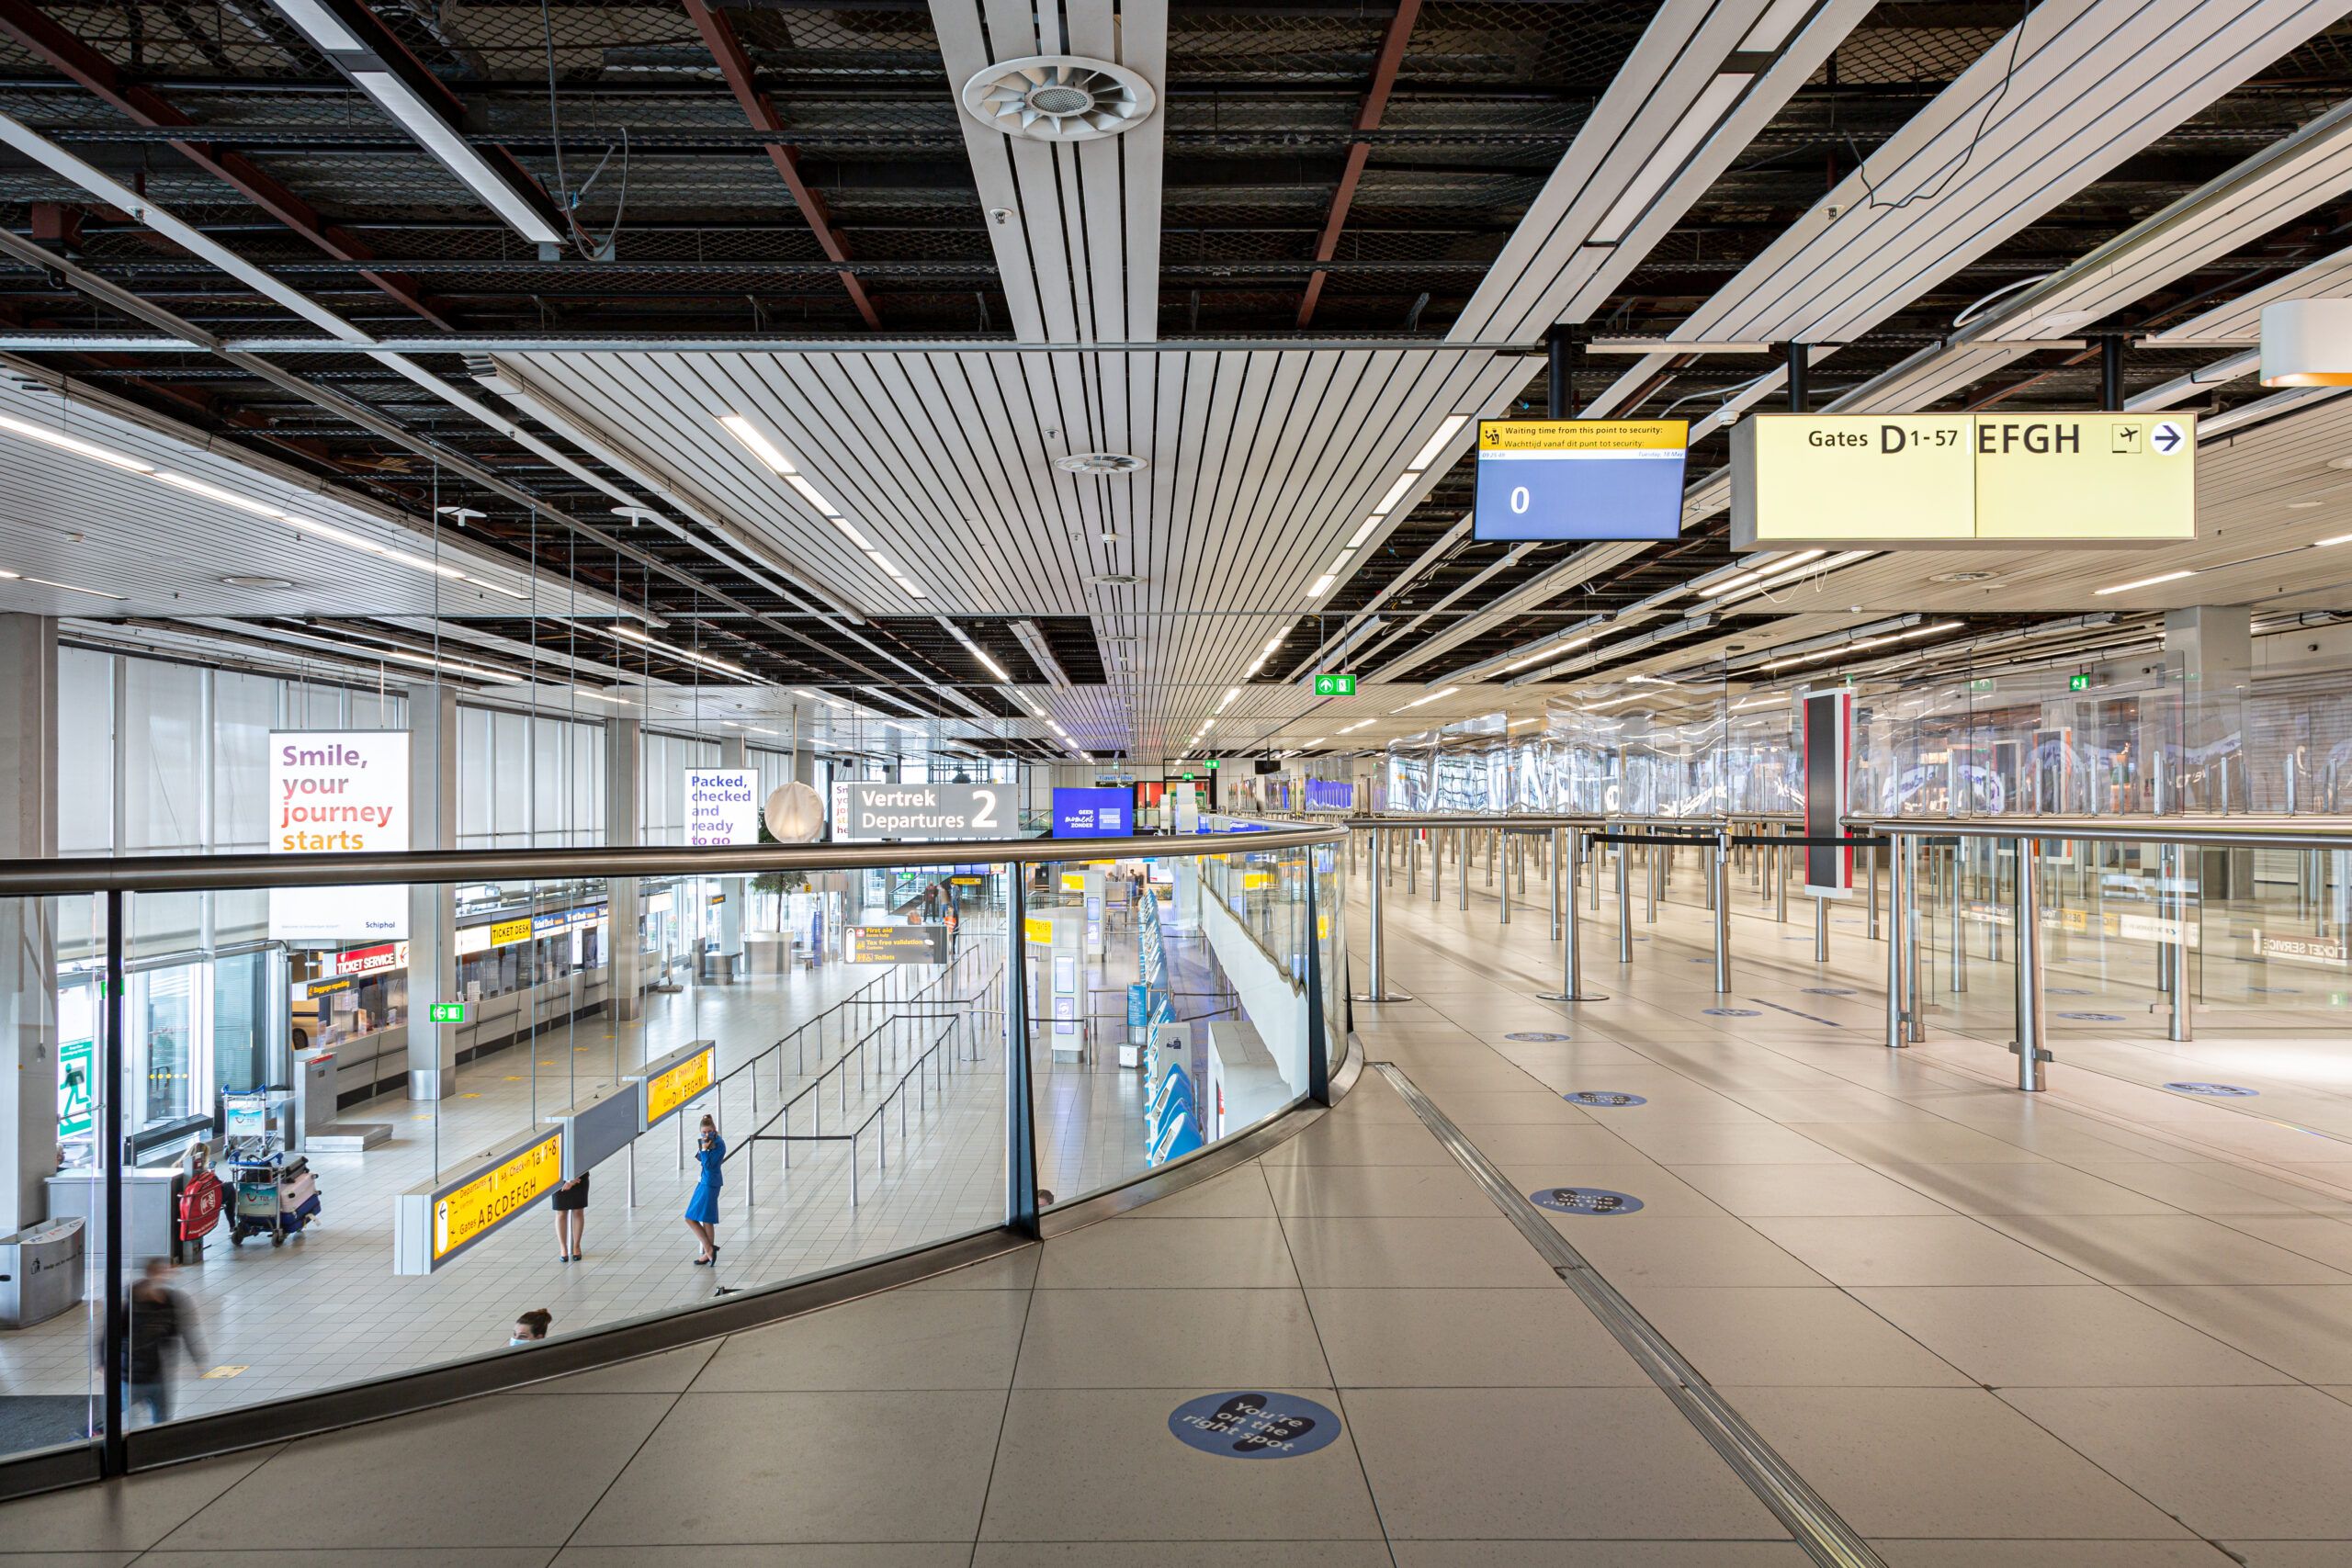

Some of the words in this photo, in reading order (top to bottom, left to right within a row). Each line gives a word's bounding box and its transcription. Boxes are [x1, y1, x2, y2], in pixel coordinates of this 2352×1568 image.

[1505, 426, 1537, 435] Waiting
[1539, 426, 1557, 434] time
[1558, 426, 1577, 434] from
[1596, 426, 1618, 435] point
[1629, 426, 1664, 435] security:
[1808, 430, 1869, 447] Gates
[1881, 425, 1906, 454] D
[1979, 424, 2080, 454] EFGH
[1504, 440, 1542, 449] Wachttijd
[1612, 440, 1645, 448] security:
[1510, 487, 1530, 514] 0
[283, 744, 368, 769] Smile,
[282, 778, 349, 800] your
[692, 775, 748, 788] Packed,
[692, 790, 752, 801] checked
[862, 789, 936, 807] Vertrek
[281, 801, 393, 829] journey
[692, 805, 719, 817] and
[971, 790, 998, 828] 2
[692, 819, 734, 834] ready
[862, 812, 965, 832] Departures
[283, 830, 364, 851] starts
[692, 835, 707, 845] to
[492, 927, 514, 939] TICKET
[515, 923, 530, 935] DESK
[337, 958, 364, 974] TICKET
[364, 953, 394, 969] SERVICE
[459, 1178, 487, 1199] Departures
[459, 1218, 477, 1235] Gates
[477, 1176, 537, 1229] ABCDEFGH
[1217, 1412, 1247, 1425] on
[1250, 1419, 1289, 1437] the
[1235, 1402, 1303, 1428] You're
[1182, 1414, 1240, 1436] right
[1239, 1430, 1296, 1451] spot
